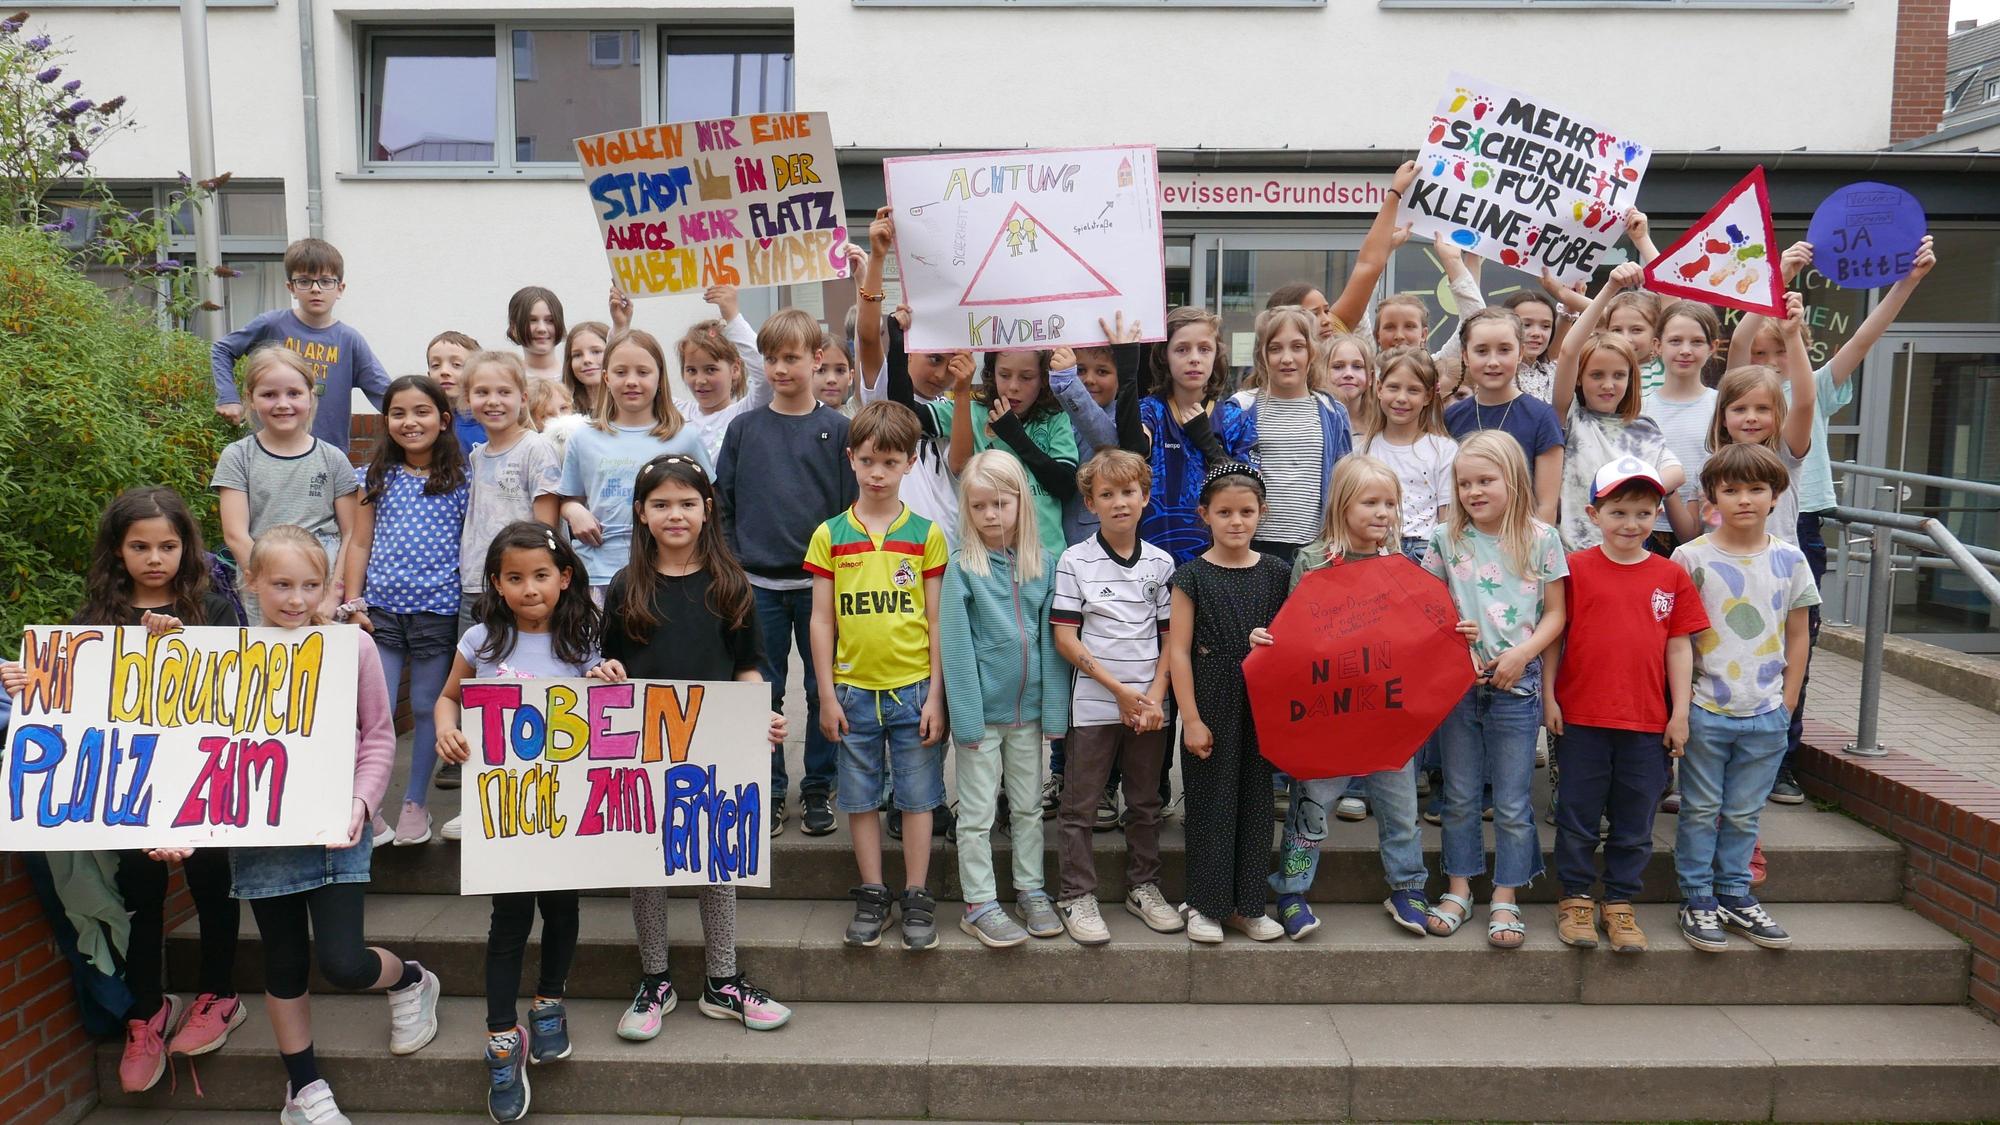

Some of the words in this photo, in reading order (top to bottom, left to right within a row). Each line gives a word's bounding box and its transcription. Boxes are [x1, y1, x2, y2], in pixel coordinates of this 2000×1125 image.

[578, 124, 682, 167] WOLLEN
[1496, 98, 1597, 159] MEHR
[589, 166, 692, 220] STADT
[772, 153, 822, 192] DER
[943, 164, 1081, 200] ACHTUNG
[1494, 168, 1561, 217] FÜR
[606, 221, 675, 250] AUTOS
[679, 208, 743, 245] MEHR
[748, 191, 837, 238] PLATZ
[1407, 178, 1532, 247] KLEINE
[1832, 226, 1872, 253] JA
[612, 247, 698, 294] HABEN
[284, 336, 338, 363] ALARM
[968, 312, 1065, 346] KINDER
[840, 590, 914, 616] REWE
[108, 625, 324, 737] brauchen
[1312, 641, 1392, 685] NEIN
[1290, 676, 1403, 722] DANKE
[9, 724, 160, 827] Platz
[478, 762, 567, 839] nicht
[662, 763, 760, 882] Parken
